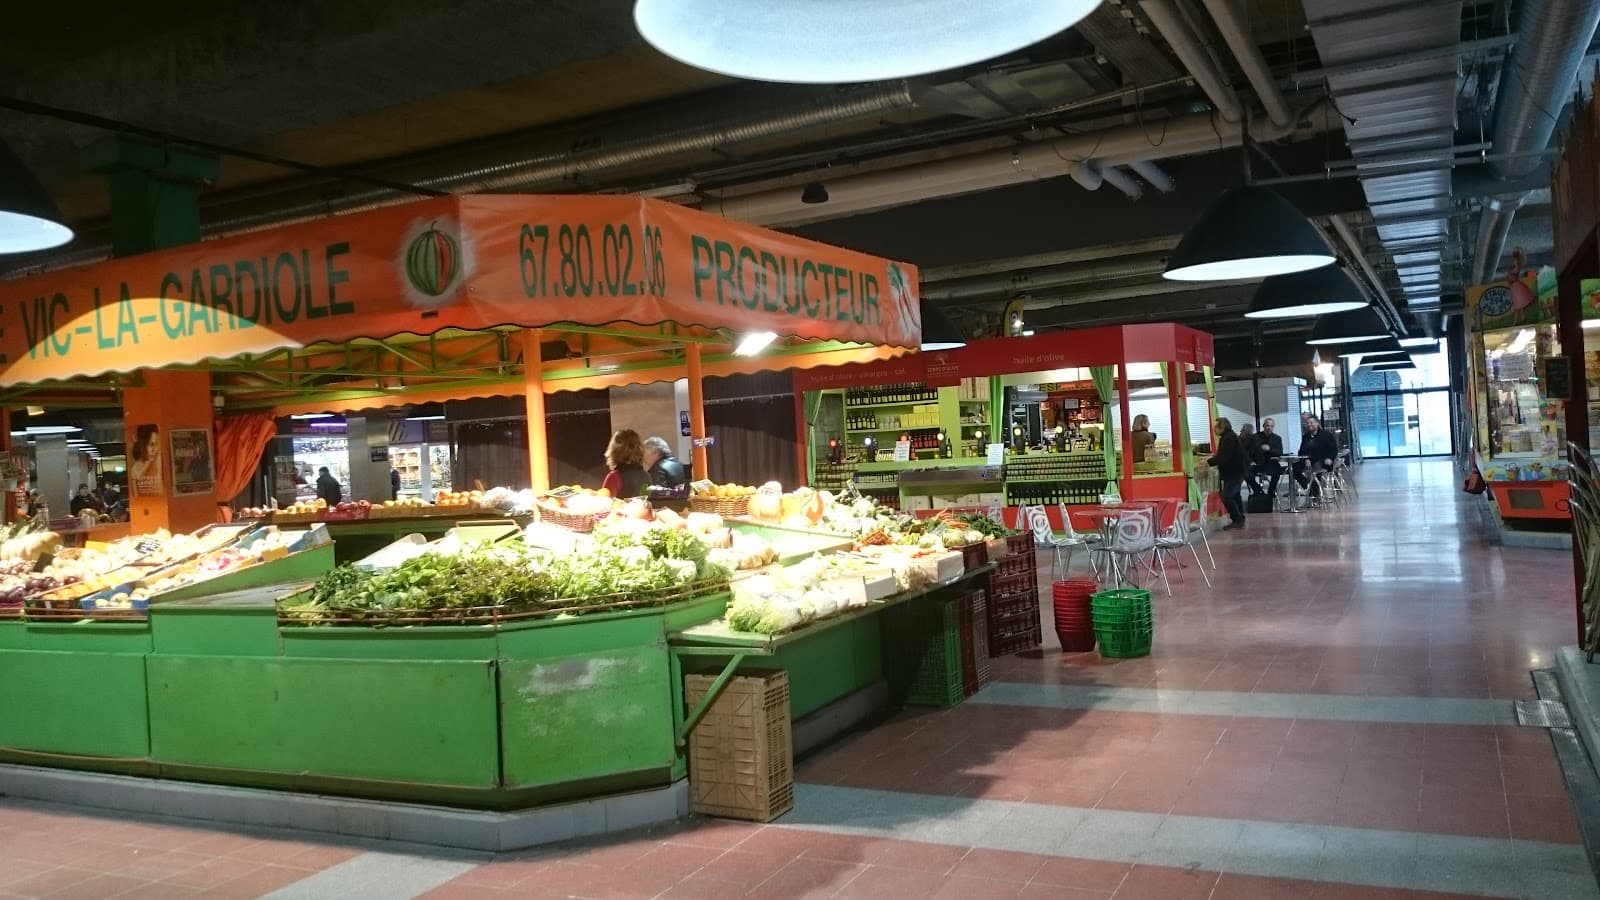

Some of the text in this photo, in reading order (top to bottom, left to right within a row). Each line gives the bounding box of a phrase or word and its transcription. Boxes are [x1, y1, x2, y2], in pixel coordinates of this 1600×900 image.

[20, 242, 354, 359] VIC-LA-GARDIOLE
[519, 223, 665, 298] 67.80.02.06
[692, 234, 880, 324] PRODUCTEUR
